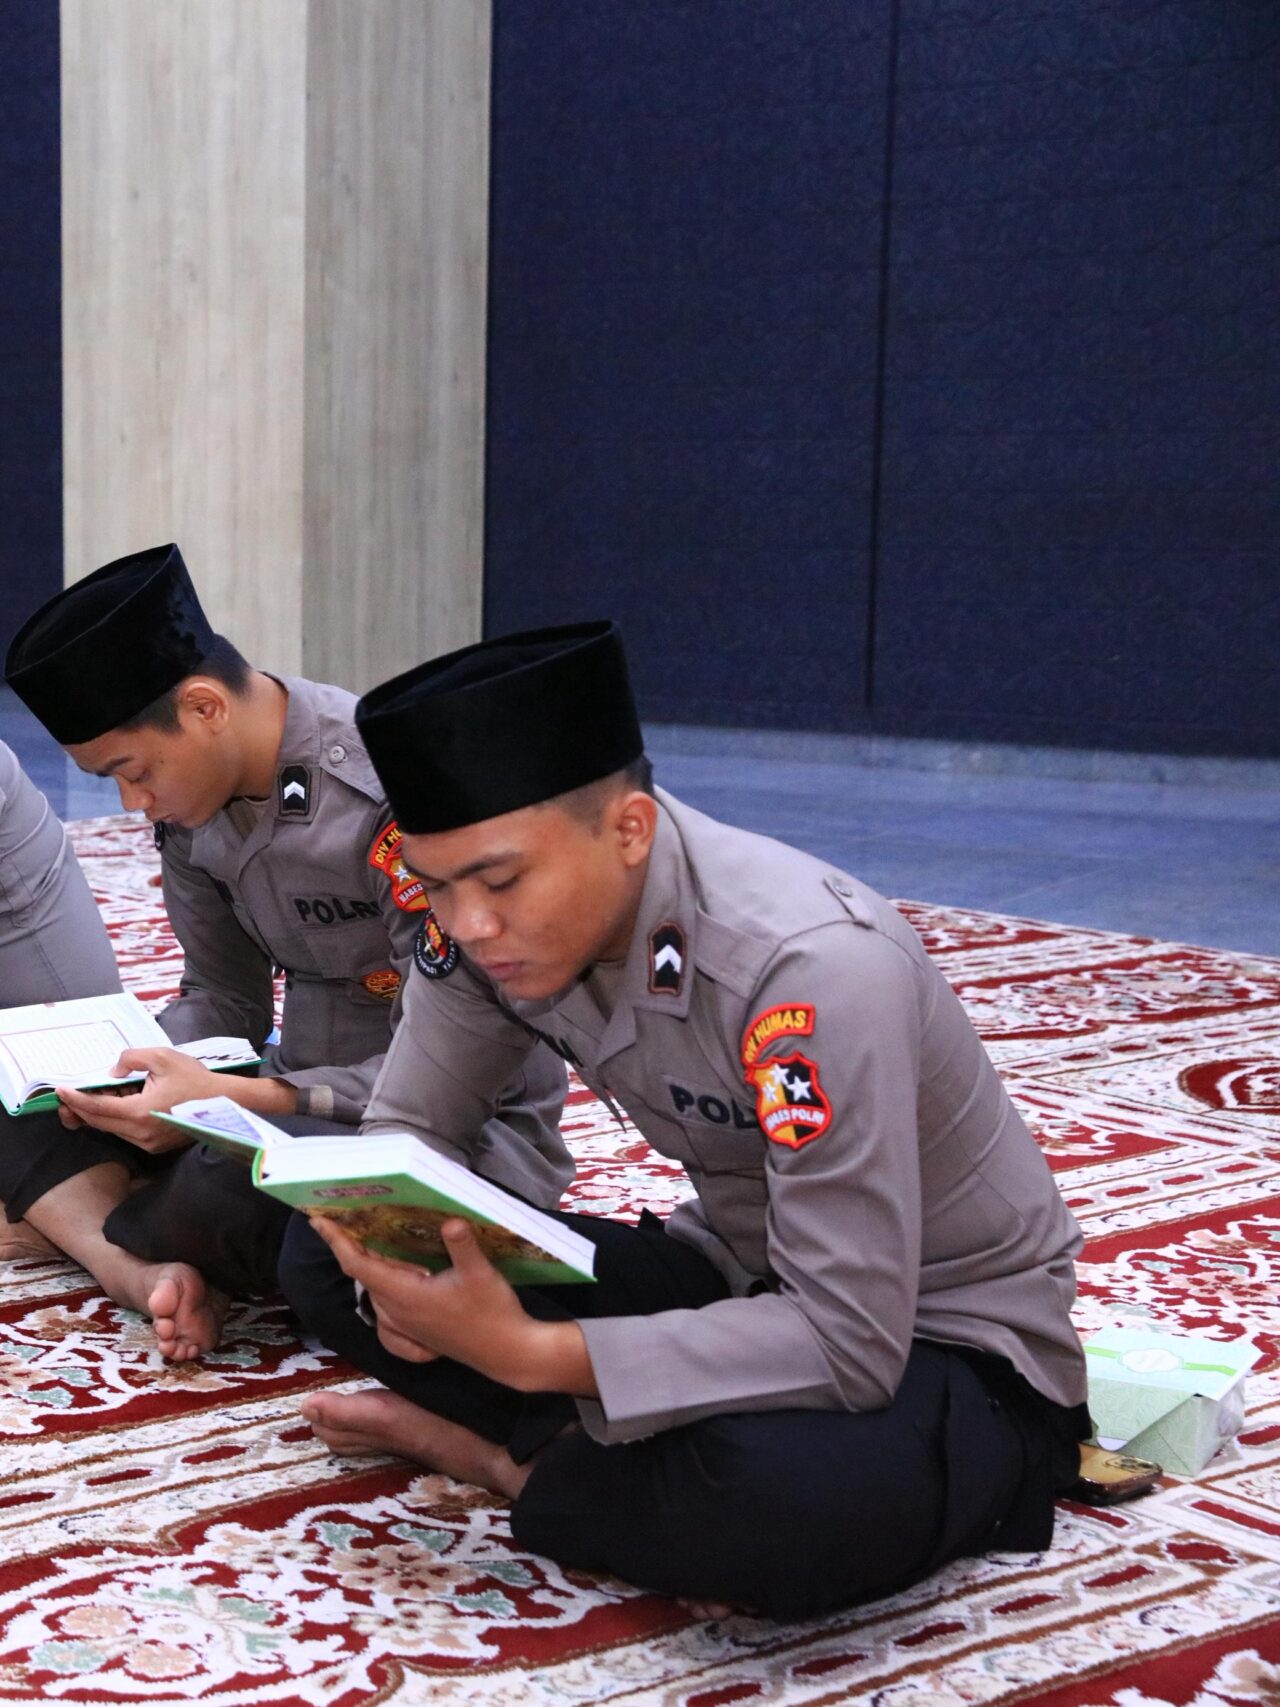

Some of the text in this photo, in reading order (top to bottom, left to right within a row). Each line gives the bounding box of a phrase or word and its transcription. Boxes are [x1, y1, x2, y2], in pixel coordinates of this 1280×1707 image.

[375, 841, 390, 864] DIV
[398, 883, 424, 903] MABES
[754, 1010, 807, 1043] HUMAS
[670, 1085, 758, 1129] POL
[790, 1107, 826, 1126] POLRI
